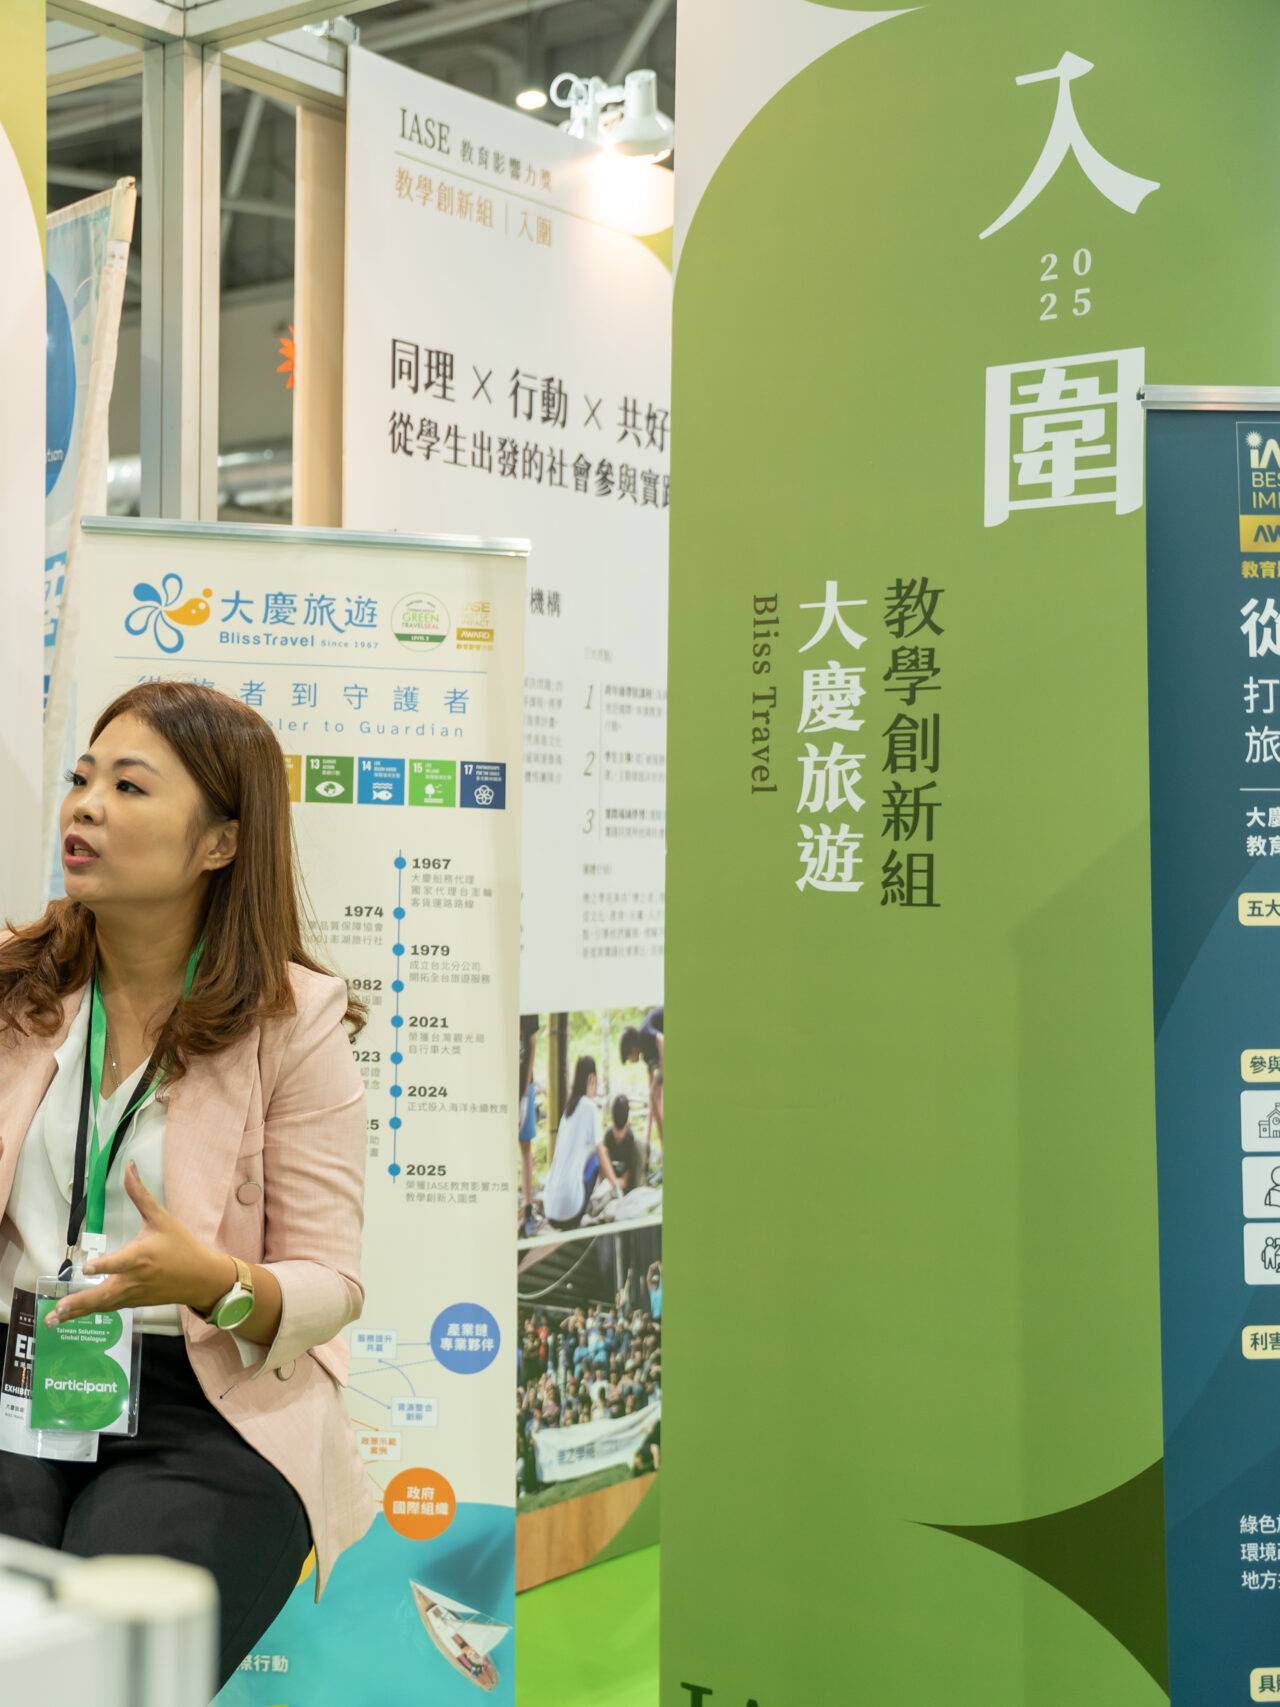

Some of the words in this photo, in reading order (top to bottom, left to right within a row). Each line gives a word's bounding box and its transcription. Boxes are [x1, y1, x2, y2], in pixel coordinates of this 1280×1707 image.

[399, 106, 451, 156] IASE
[460, 139, 553, 194] 教育影響力獎
[978, 50, 1161, 240] 入
[394, 166, 494, 229] 教學創新組
[518, 210, 553, 248] 入圍
[1039, 248, 1093, 281] 20
[1039, 287, 1093, 321] 25
[390, 337, 456, 402] 同理
[508, 366, 568, 430] 行動
[616, 395, 670, 454] 共好
[983, 346, 1146, 528] 圍
[1252, 491, 1280, 509] IM
[1241, 560, 1280, 580] 教育
[220, 589, 379, 634] 大慶旅遊
[752, 592, 780, 676] Bliss
[320, 639, 349, 649] Since
[353, 640, 379, 650] 1967
[1243, 675, 1280, 714] 打
[324, 719, 344, 734] to
[359, 720, 464, 738] Guardian
[795, 579, 869, 893] 大慶旅遊
[750, 686, 778, 795] Travel
[880, 575, 946, 908] 教學創新組
[1244, 725, 1280, 764] 旅
[309, 758, 320, 770] 13
[361, 760, 372, 771] 14
[413, 762, 423, 773] 15
[463, 764, 474, 775] 17
[412, 857, 452, 870] 1967
[344, 905, 384, 918] 1974
[1246, 898, 1280, 918] 五大
[410, 944, 450, 957] 1979
[408, 1016, 449, 1029] 2021
[407, 1085, 448, 1098] 2024
[406, 1164, 447, 1176] 2025
[44, 1378, 118, 1394] Participant
[406, 1485, 436, 1501] 政府
[392, 1501, 450, 1517] 國際組織
[1239, 1514, 1280, 1535] 綠色
[1240, 1541, 1280, 1563] 環境
[1240, 1570, 1280, 1590] 地方
[1258, 1674, 1280, 1694] 具
